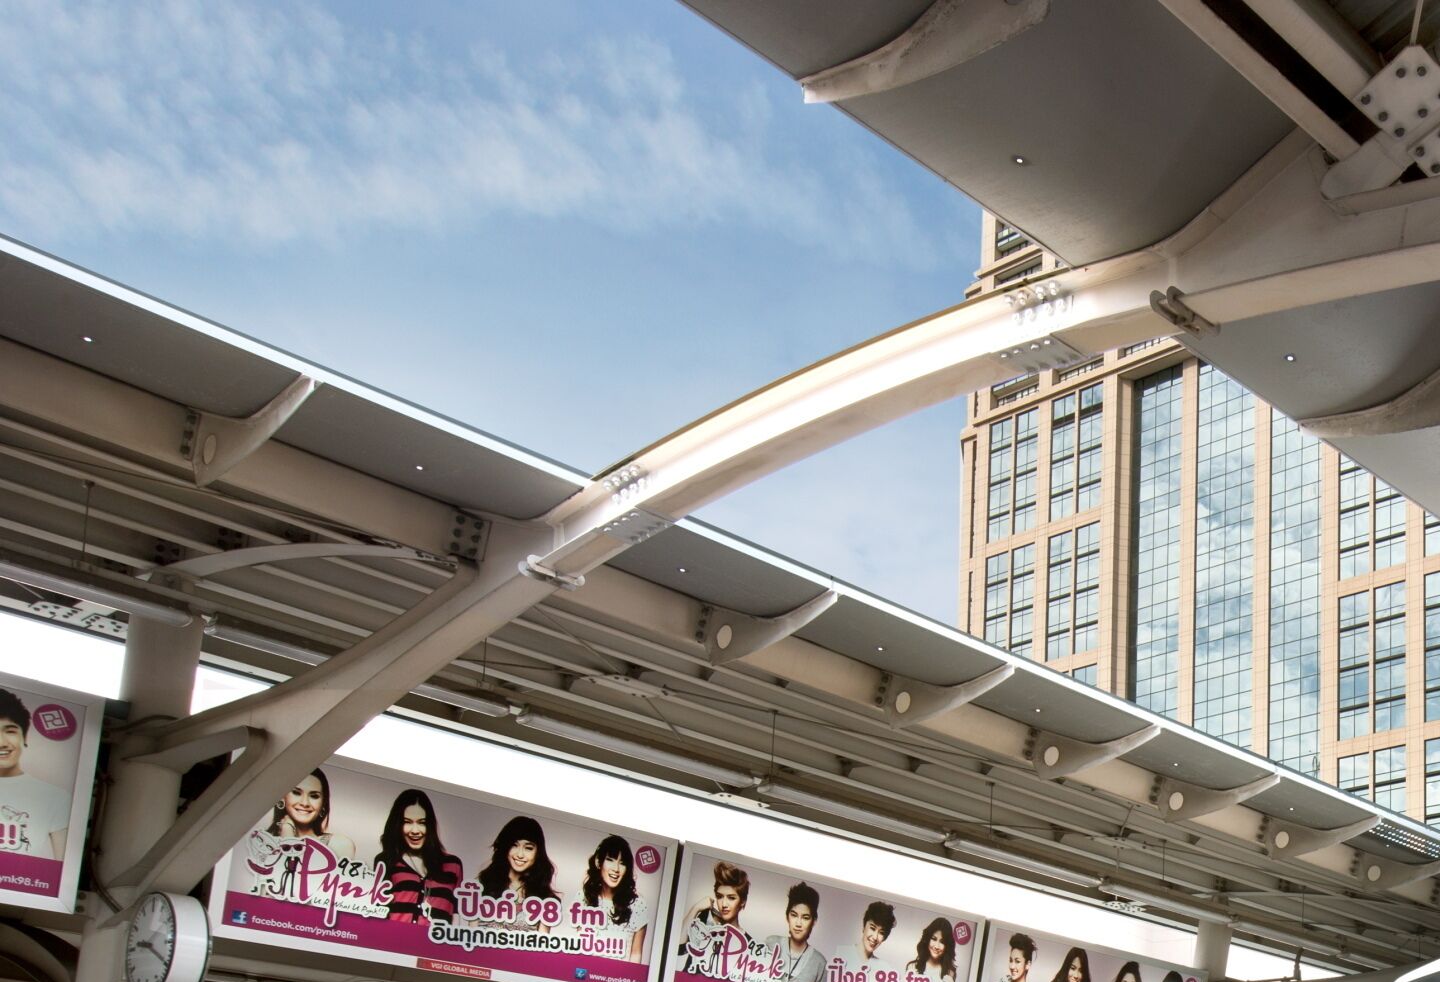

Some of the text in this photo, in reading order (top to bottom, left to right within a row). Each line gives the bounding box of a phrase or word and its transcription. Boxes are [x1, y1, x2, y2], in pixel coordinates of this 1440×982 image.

[338, 858, 362, 877] 98
[525, 899, 559, 924] 98
[569, 902, 604, 926] fm
[251, 915, 358, 940] facebook.com/pynk98fm
[443, 964, 468, 975] GLOBAL
[469, 968, 490, 978] MEDIA
